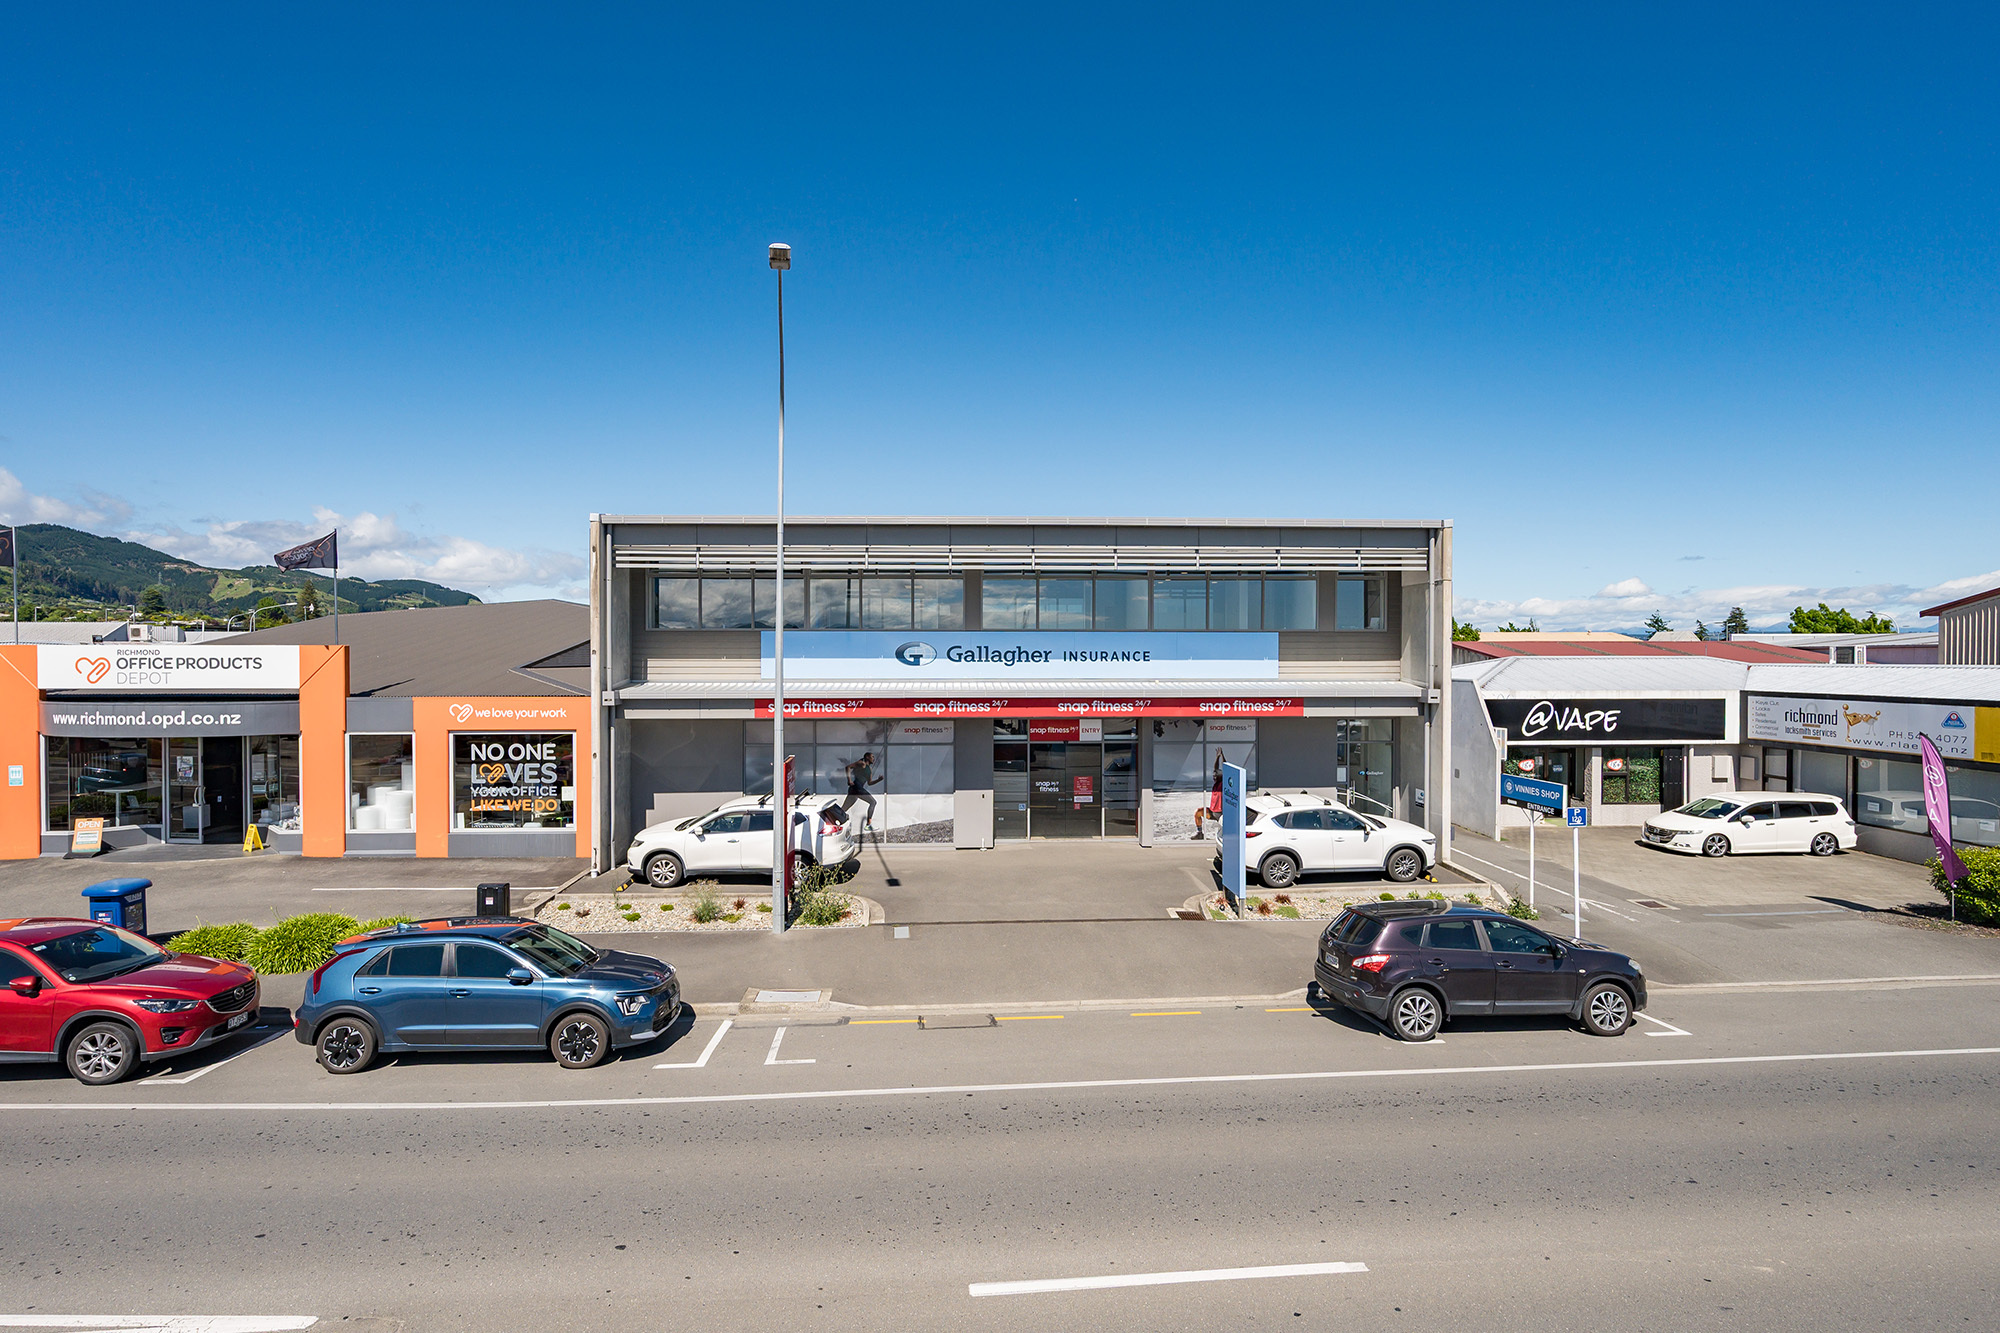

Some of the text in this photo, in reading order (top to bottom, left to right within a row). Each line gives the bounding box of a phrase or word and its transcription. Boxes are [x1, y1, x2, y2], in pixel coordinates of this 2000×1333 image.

[946, 645, 1052, 666] Gallagher
[1063, 650, 1151, 662] INSURANCE
[116, 657, 263, 670] OFFICE PRODUCTS
[117, 672, 172, 685] DEPOT
[767, 700, 864, 715] sap fitness 24/7
[913, 700, 1008, 715] snap fitness 24/7
[1057, 699, 1151, 714] snap fitness 24/7
[1199, 699, 1291, 714] snap fitness 24/7
[53, 711, 242, 729] www.richmond.opd.co.nz
[475, 707, 567, 720] we love your work
[1521, 700, 1621, 737] @VAPE
[1784, 707, 1838, 725] richmond
[1030, 727, 1047, 735] snap
[1047, 726, 1070, 734] fitness
[1784, 726, 1837, 738] locksmith services
[1936, 734, 1968, 744] 4077
[470, 743, 557, 761] NO ONE
[470, 785, 558, 797] YOUR OFFICE
[1514, 784, 1561, 800] VINNIES SHOP
[471, 799, 558, 812] LIKE WE DO
[1527, 802, 1555, 815] ENTRANCE
[1573, 808, 1581, 816] P
[77, 820, 101, 829] OPEN
